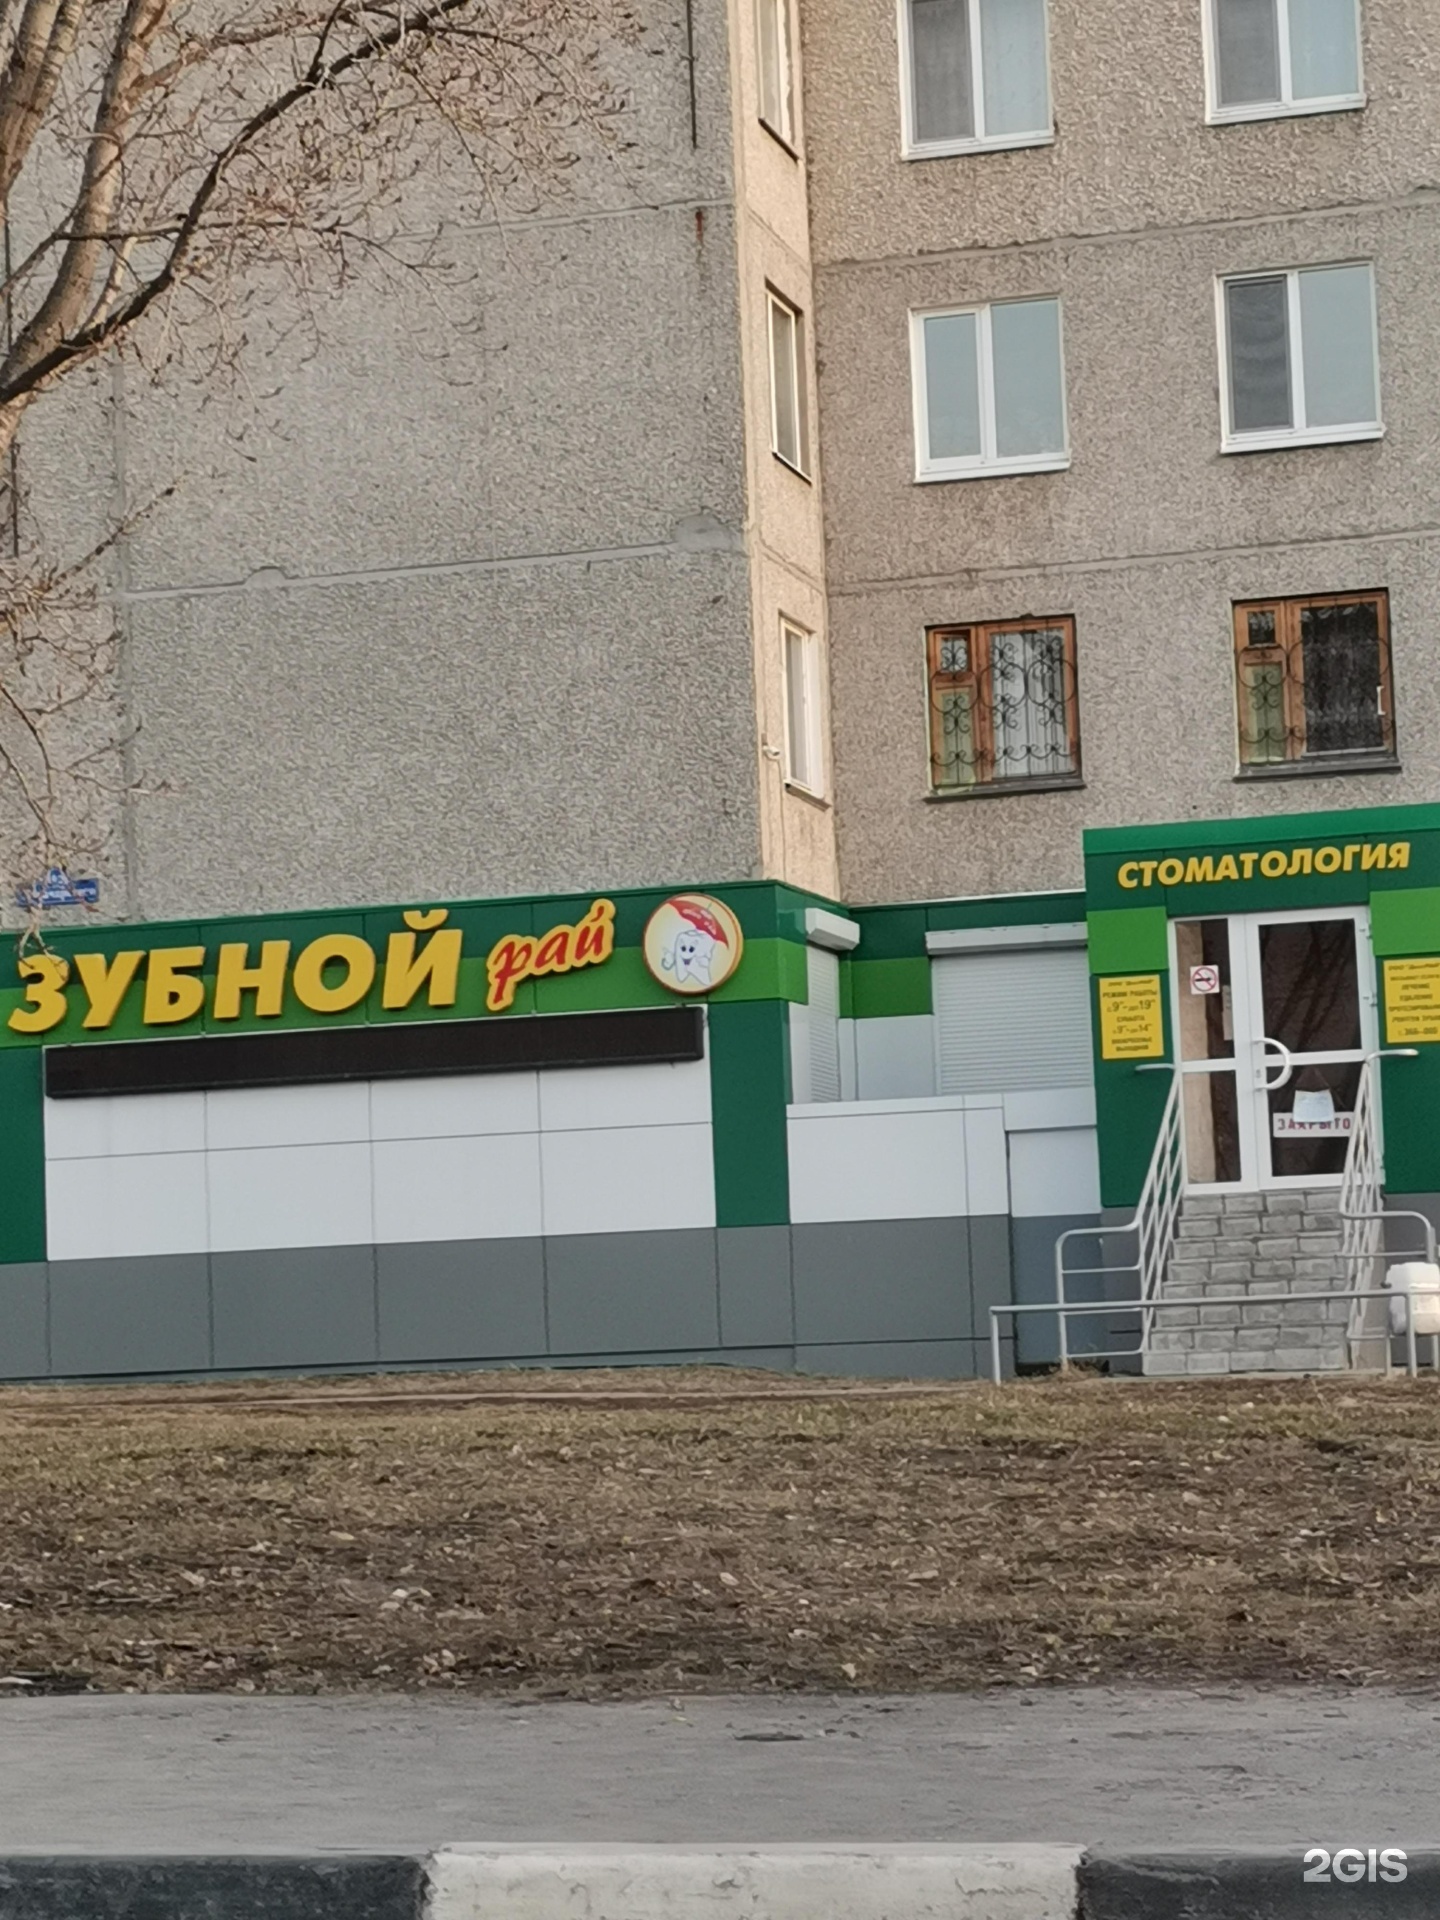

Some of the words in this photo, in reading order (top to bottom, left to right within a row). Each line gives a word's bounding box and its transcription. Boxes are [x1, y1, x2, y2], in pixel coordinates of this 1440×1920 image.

[1117, 842, 1411, 889] СТОМАТОЛОГИЯ
[8, 909, 463, 1033] ЗУБНОЙ
[490, 900, 612, 1008] рай
